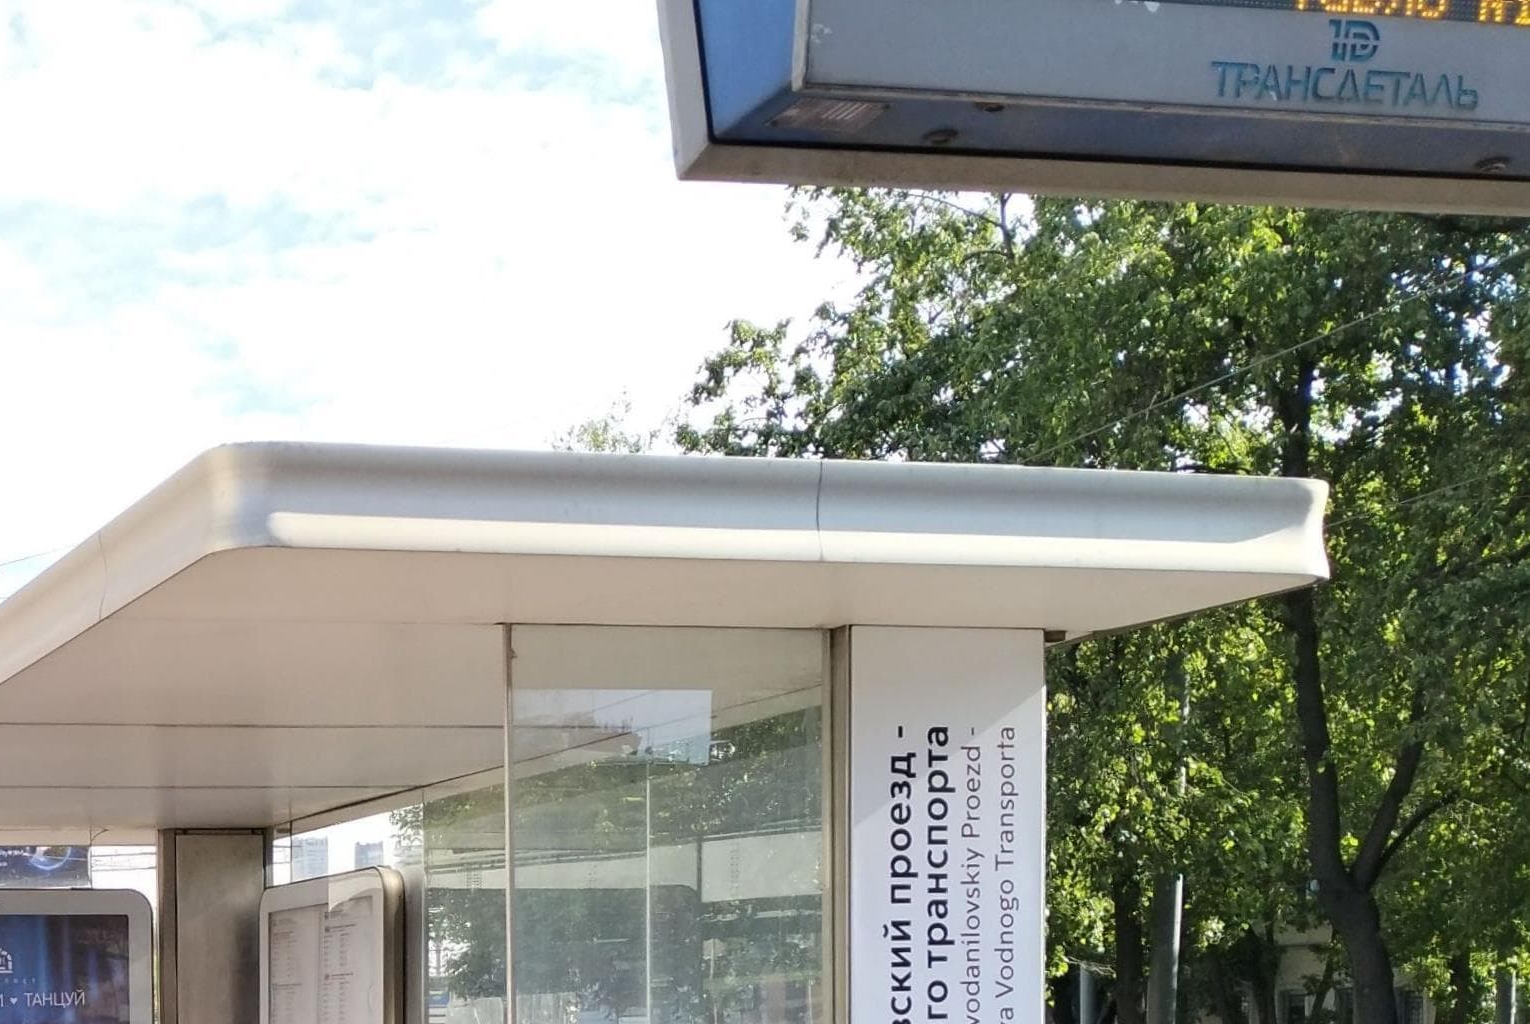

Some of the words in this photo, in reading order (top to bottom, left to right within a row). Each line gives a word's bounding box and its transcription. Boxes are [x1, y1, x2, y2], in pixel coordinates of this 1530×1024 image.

[1211, 61, 1479, 111] ТРАНСДЕТАЛЬ
[890, 753, 918, 904] проезд
[927, 726, 955, 968] транспорта
[960, 746, 981, 837] Proezd
[994, 726, 1019, 871] Transporta
[994, 879, 1019, 998] Vodnogo
[24, 989, 85, 1009] ТАНЦУЙ
